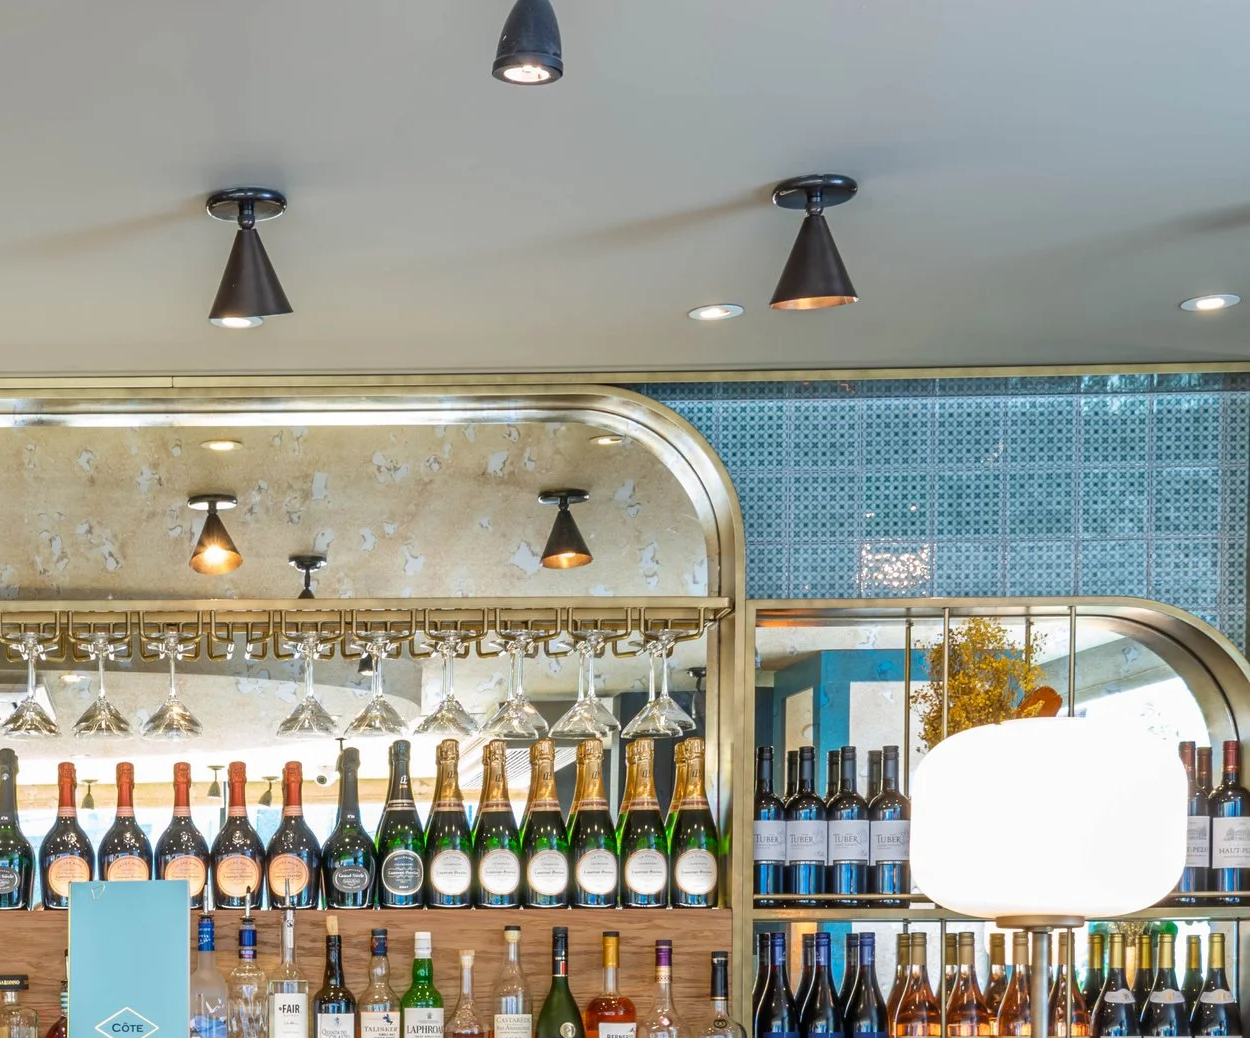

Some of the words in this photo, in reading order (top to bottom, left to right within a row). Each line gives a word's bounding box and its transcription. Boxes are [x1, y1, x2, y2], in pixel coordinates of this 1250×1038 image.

[754, 834, 781, 844] TUBER
[790, 834, 816, 844] TUBER
[833, 834, 859, 844] TUBER
[876, 834, 902, 844] TUBER
[282, 1004, 301, 1014] FAIR
[111, 1021, 144, 1033] CÔTE
